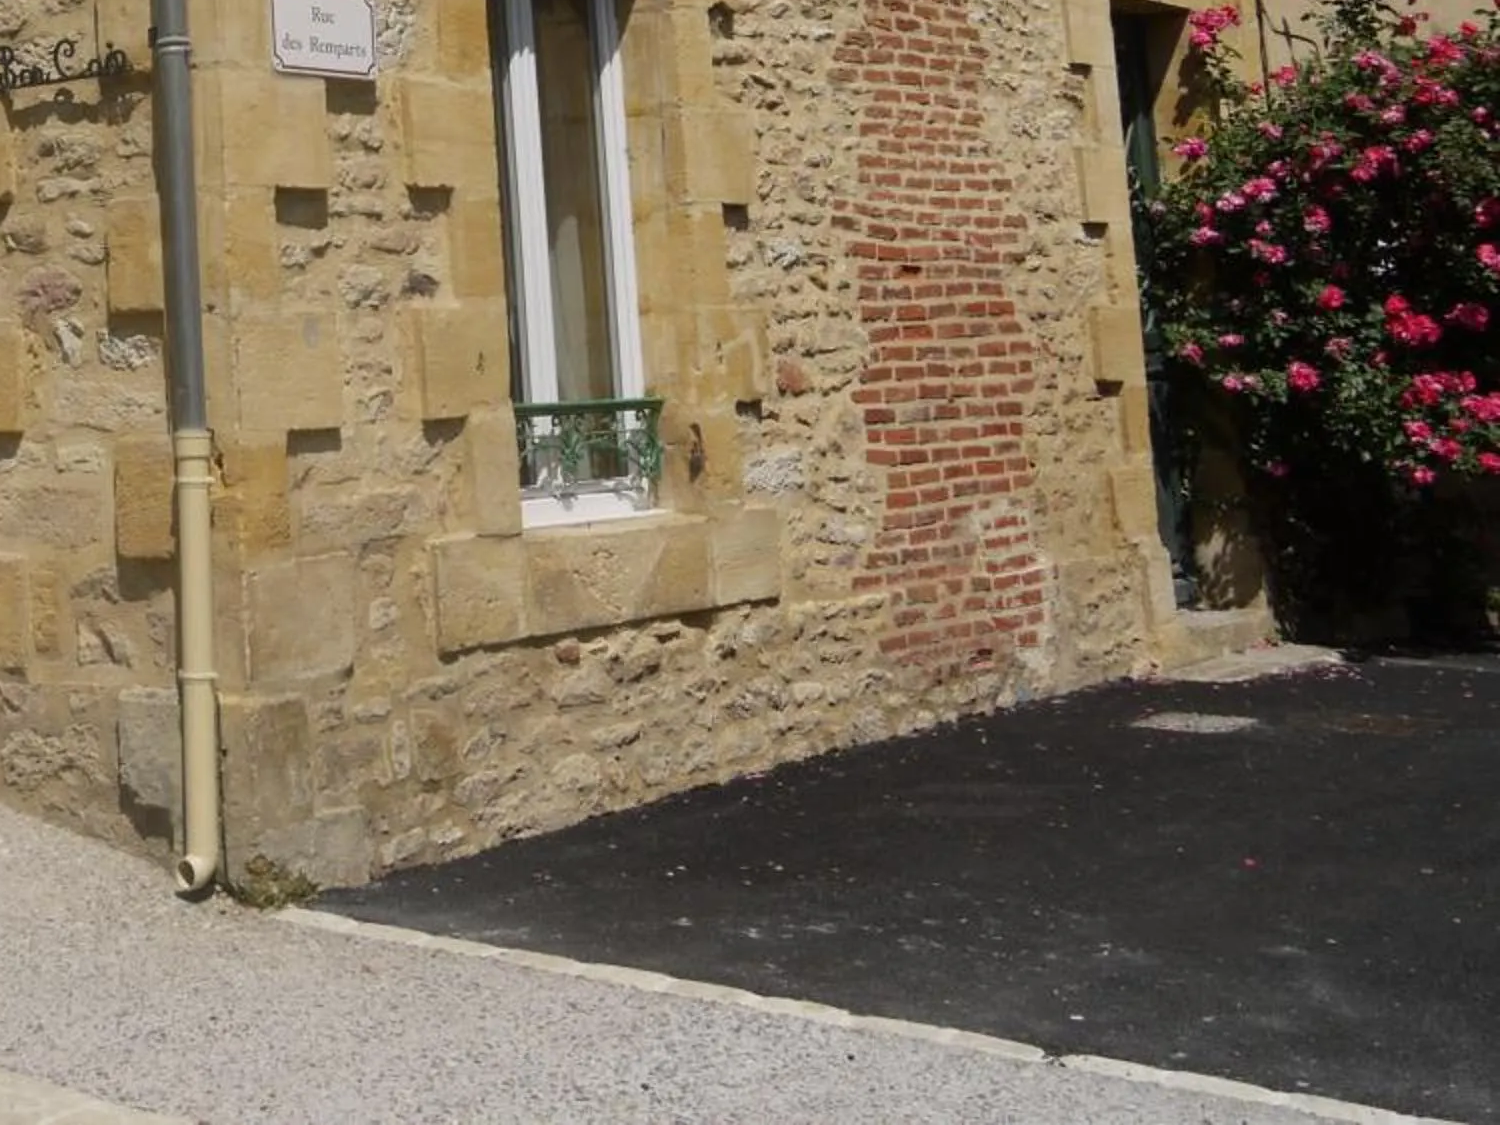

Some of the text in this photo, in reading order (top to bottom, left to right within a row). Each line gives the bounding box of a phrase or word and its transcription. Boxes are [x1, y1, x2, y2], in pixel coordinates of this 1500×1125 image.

[311, 6, 335, 25] Rue
[281, 32, 368, 59] des Remparts
